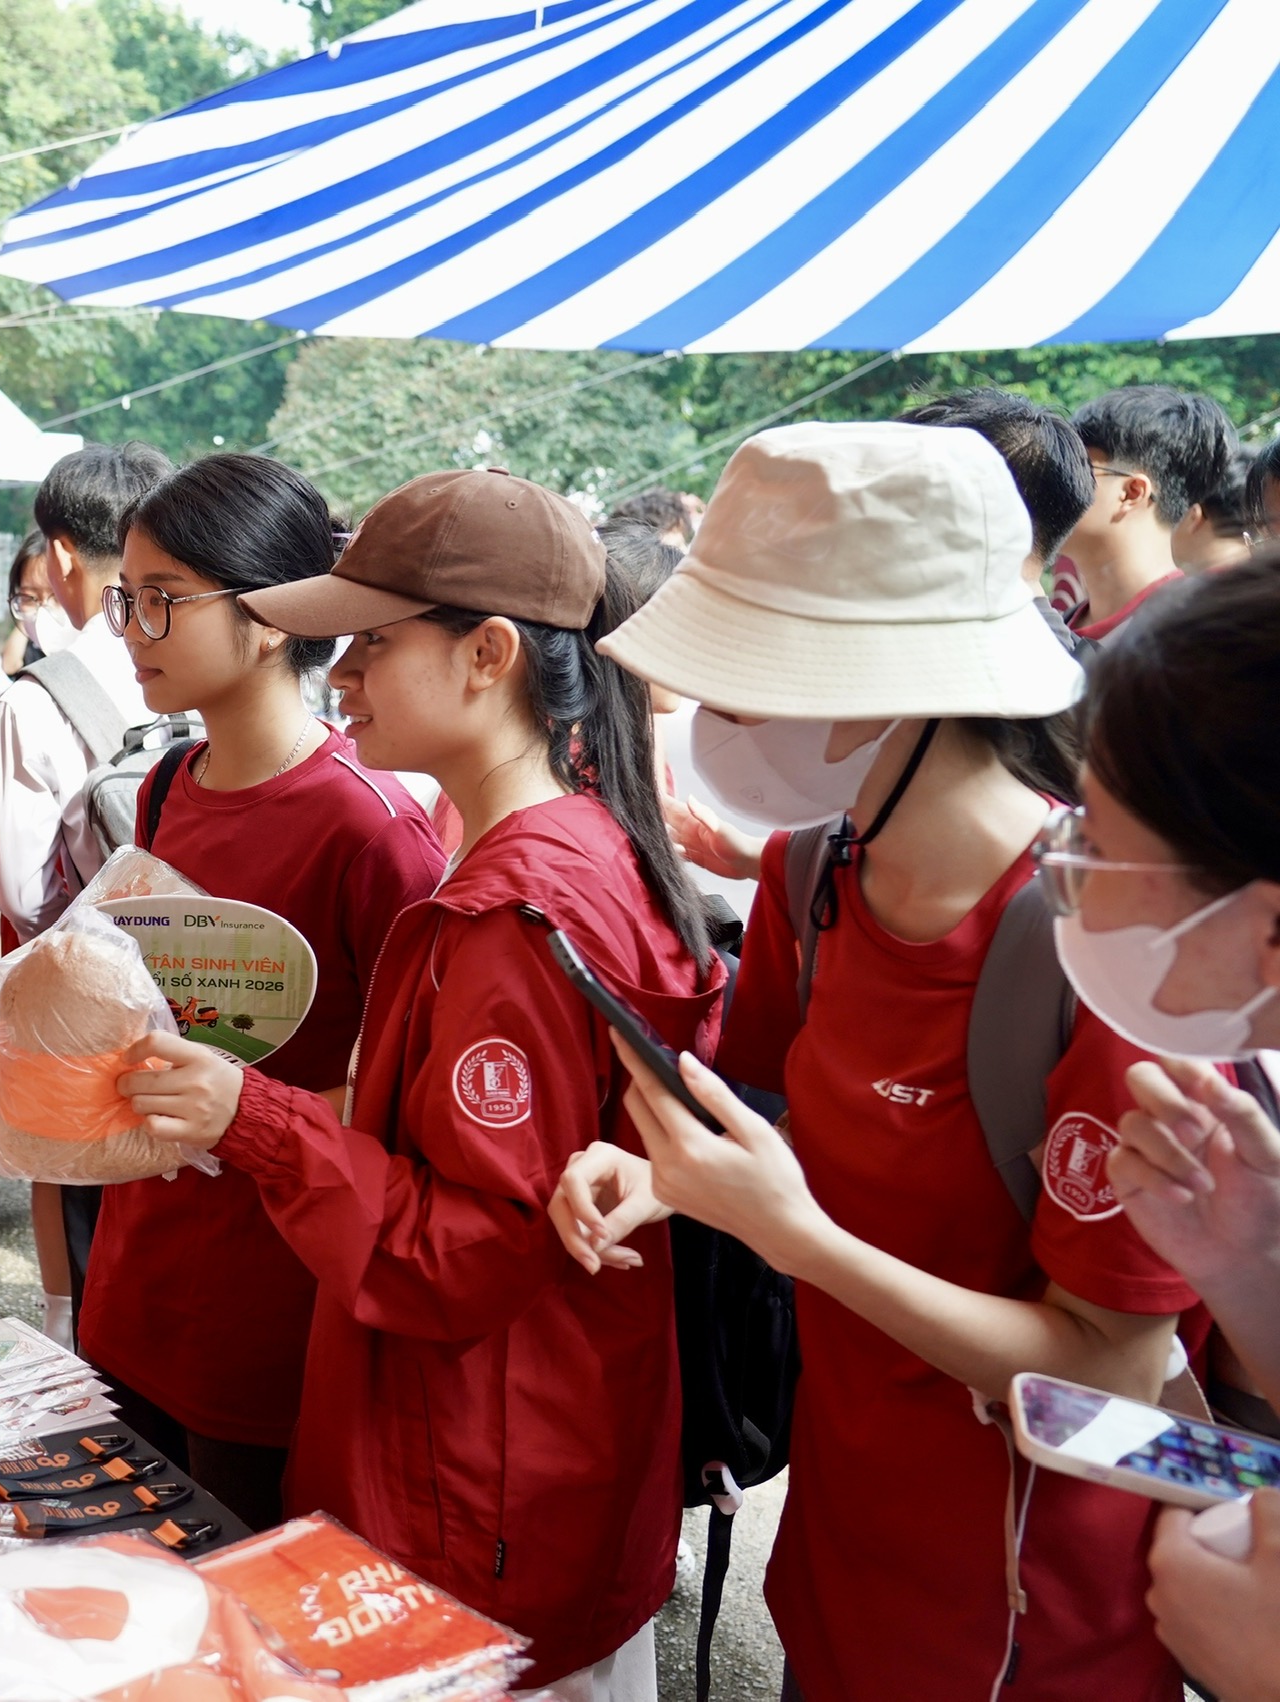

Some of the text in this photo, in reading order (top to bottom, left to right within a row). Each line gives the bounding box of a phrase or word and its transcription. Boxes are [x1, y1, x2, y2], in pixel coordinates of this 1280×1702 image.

[221, 921, 265, 930] Insurance
[150, 953, 285, 974] TÂN SINH VIÊN
[153, 971, 285, 992] ỔI SỐ XANH 2026
[487, 1103, 512, 1112] 1956
